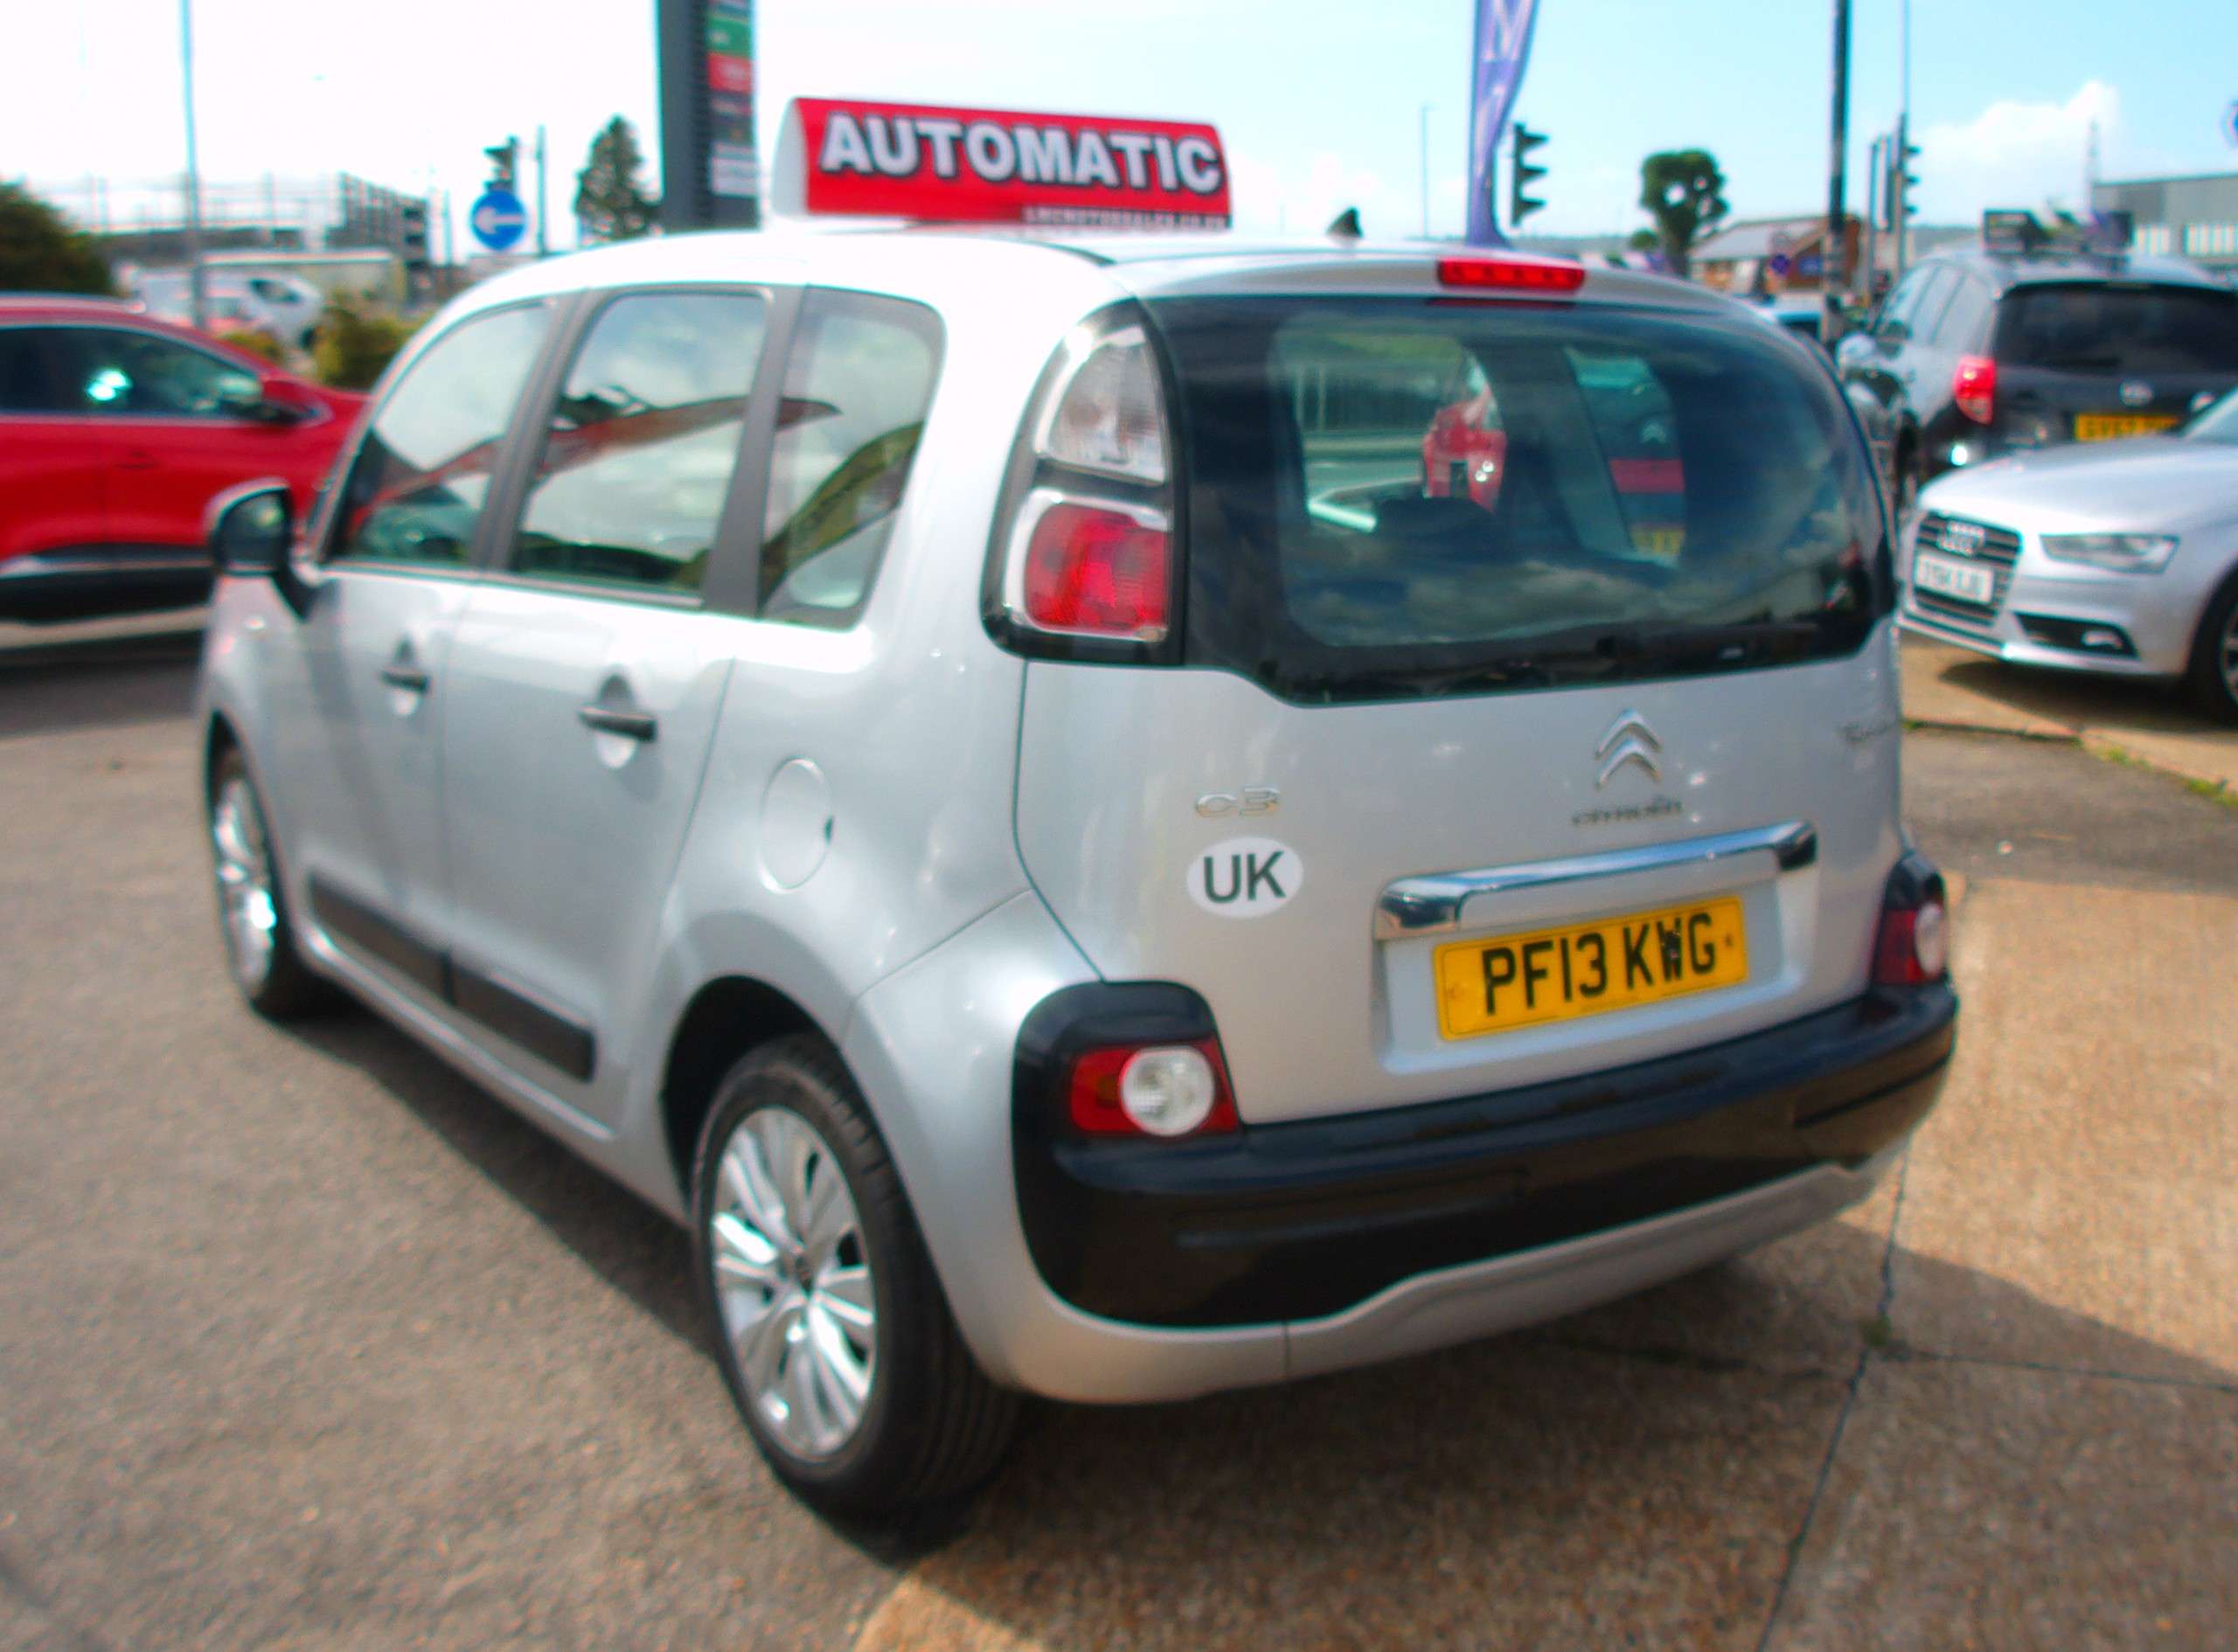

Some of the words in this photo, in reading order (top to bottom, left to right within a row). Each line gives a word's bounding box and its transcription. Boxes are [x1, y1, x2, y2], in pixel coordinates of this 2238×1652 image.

[819, 111, 1221, 195] AUTOMATIC
[1196, 786, 1282, 818] C3
[1204, 850, 1287, 904] UK
[1482, 932, 1608, 1015] PF13
